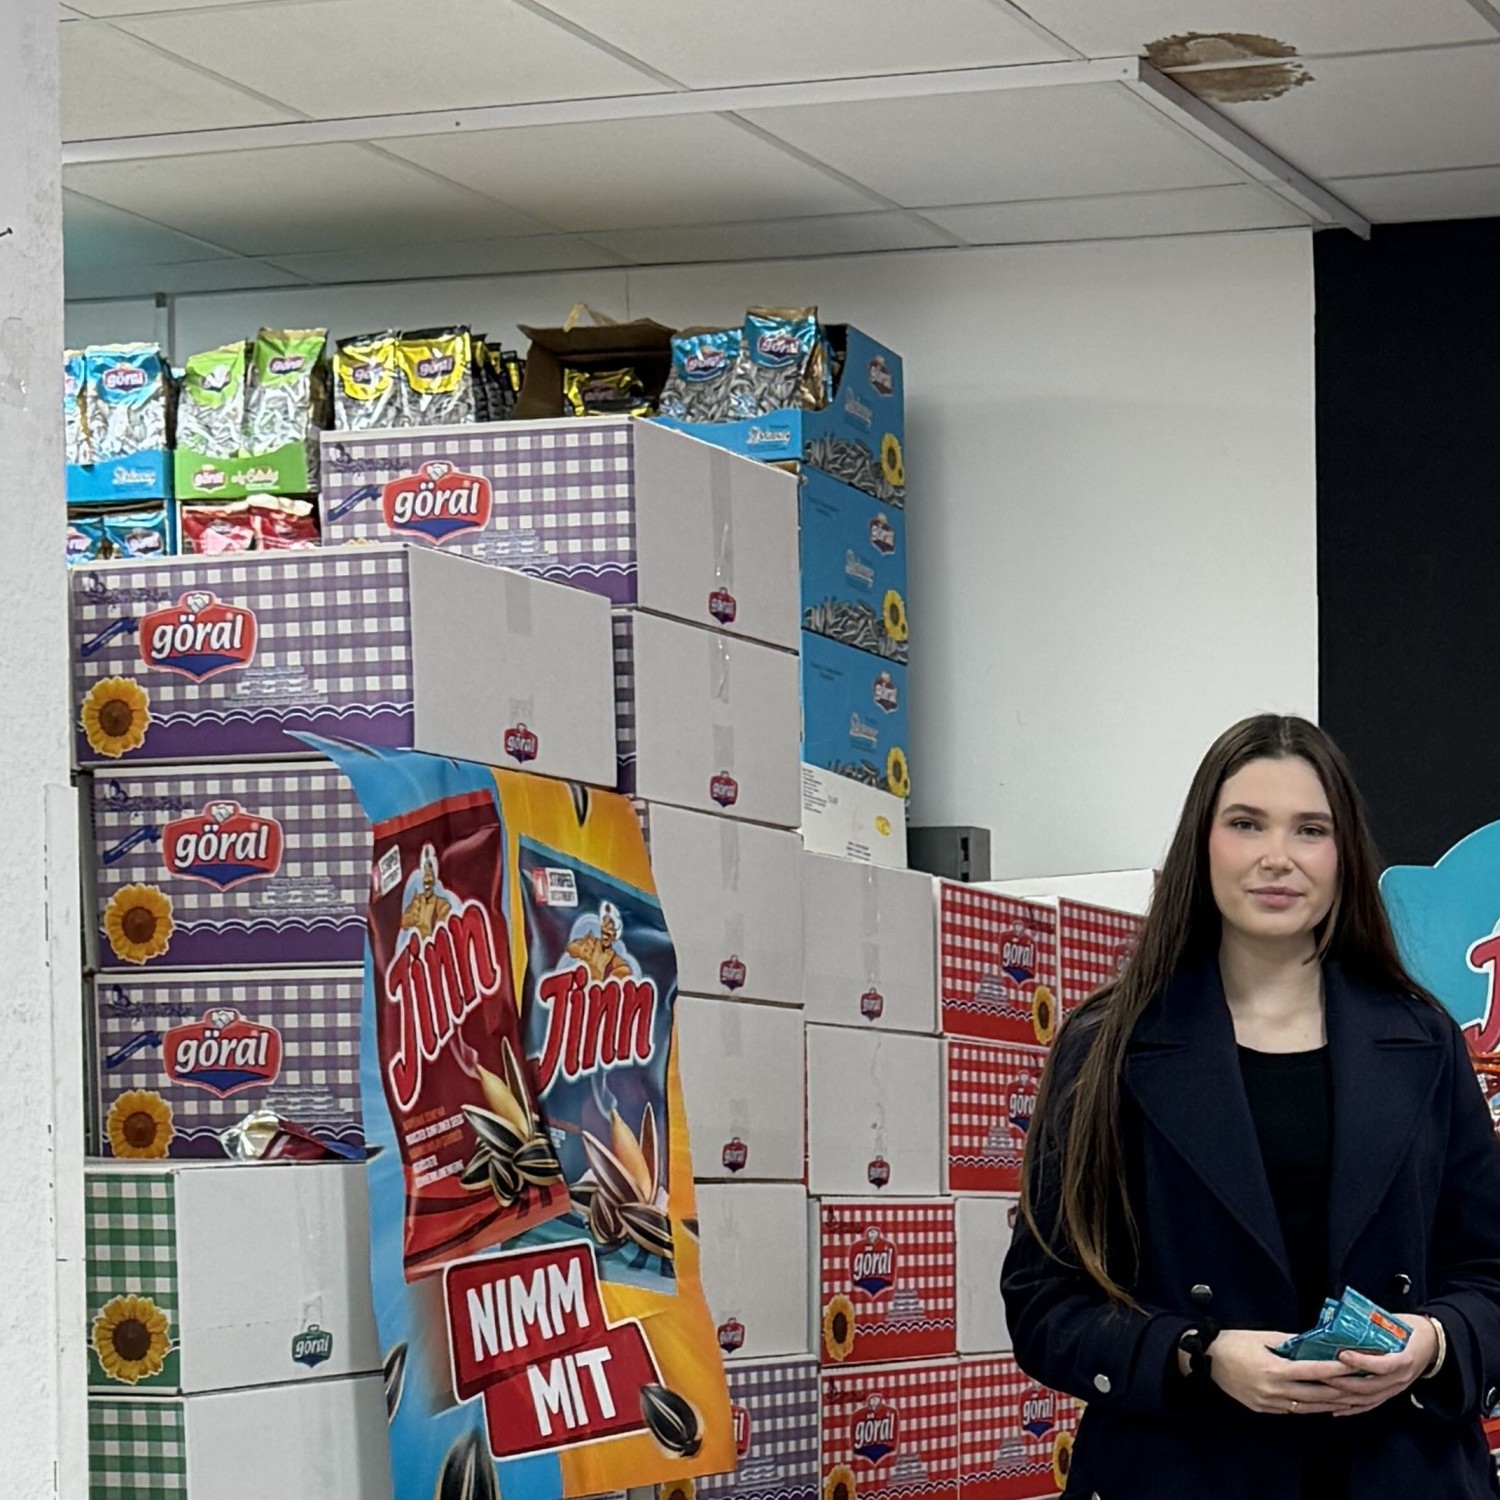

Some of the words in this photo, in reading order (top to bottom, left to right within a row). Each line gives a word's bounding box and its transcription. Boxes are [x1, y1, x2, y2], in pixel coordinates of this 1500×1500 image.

[393, 482, 479, 523] göral
[151, 613, 244, 658] göral
[174, 824, 267, 867] göral
[1003, 937, 1034, 968] göral
[387, 901, 500, 1109] Jinn
[175, 1030, 267, 1072] göral
[537, 965, 656, 1095] Jinn
[853, 1244, 893, 1281] göral
[466, 1257, 590, 1363] NIMM
[527, 1346, 617, 1437] MIT
[1022, 1390, 1053, 1424] göral
[855, 1411, 895, 1446] göral
